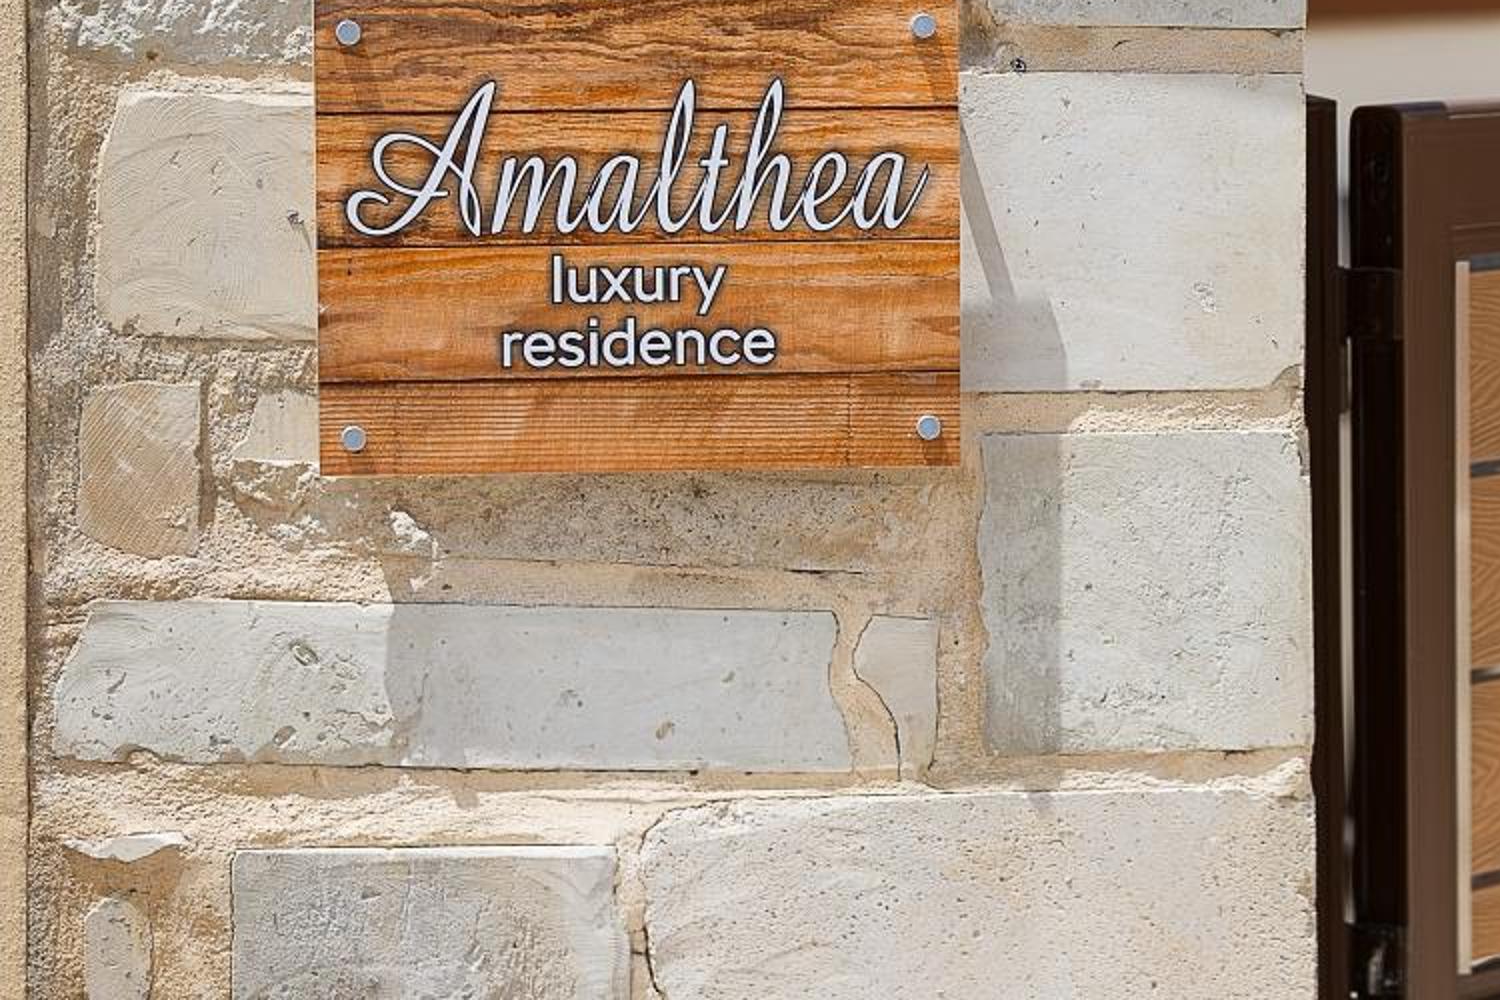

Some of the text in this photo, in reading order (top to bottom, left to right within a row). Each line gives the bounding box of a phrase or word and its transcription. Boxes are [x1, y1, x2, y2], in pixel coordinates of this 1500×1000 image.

[344, 78, 931, 237] Amalthea
[551, 254, 727, 315] luxury
[501, 317, 777, 369] residence
